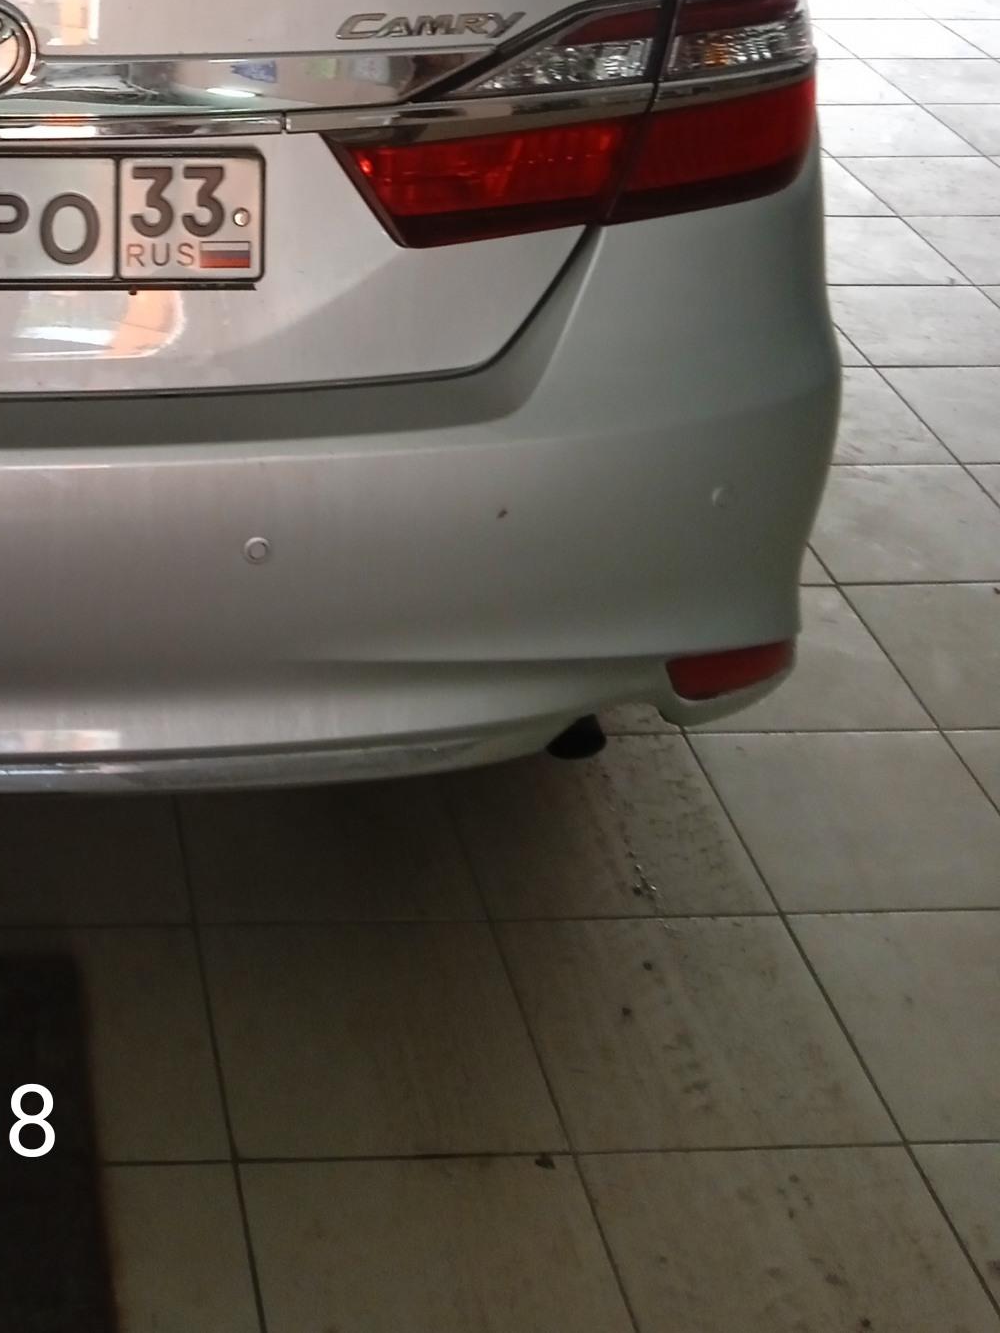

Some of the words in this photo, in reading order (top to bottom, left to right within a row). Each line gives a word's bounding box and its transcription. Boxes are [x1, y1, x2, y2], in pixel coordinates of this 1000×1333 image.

[336, 11, 527, 40] CAMRY
[131, 166, 215, 238] 33
[126, 241, 196, 267] RUS
